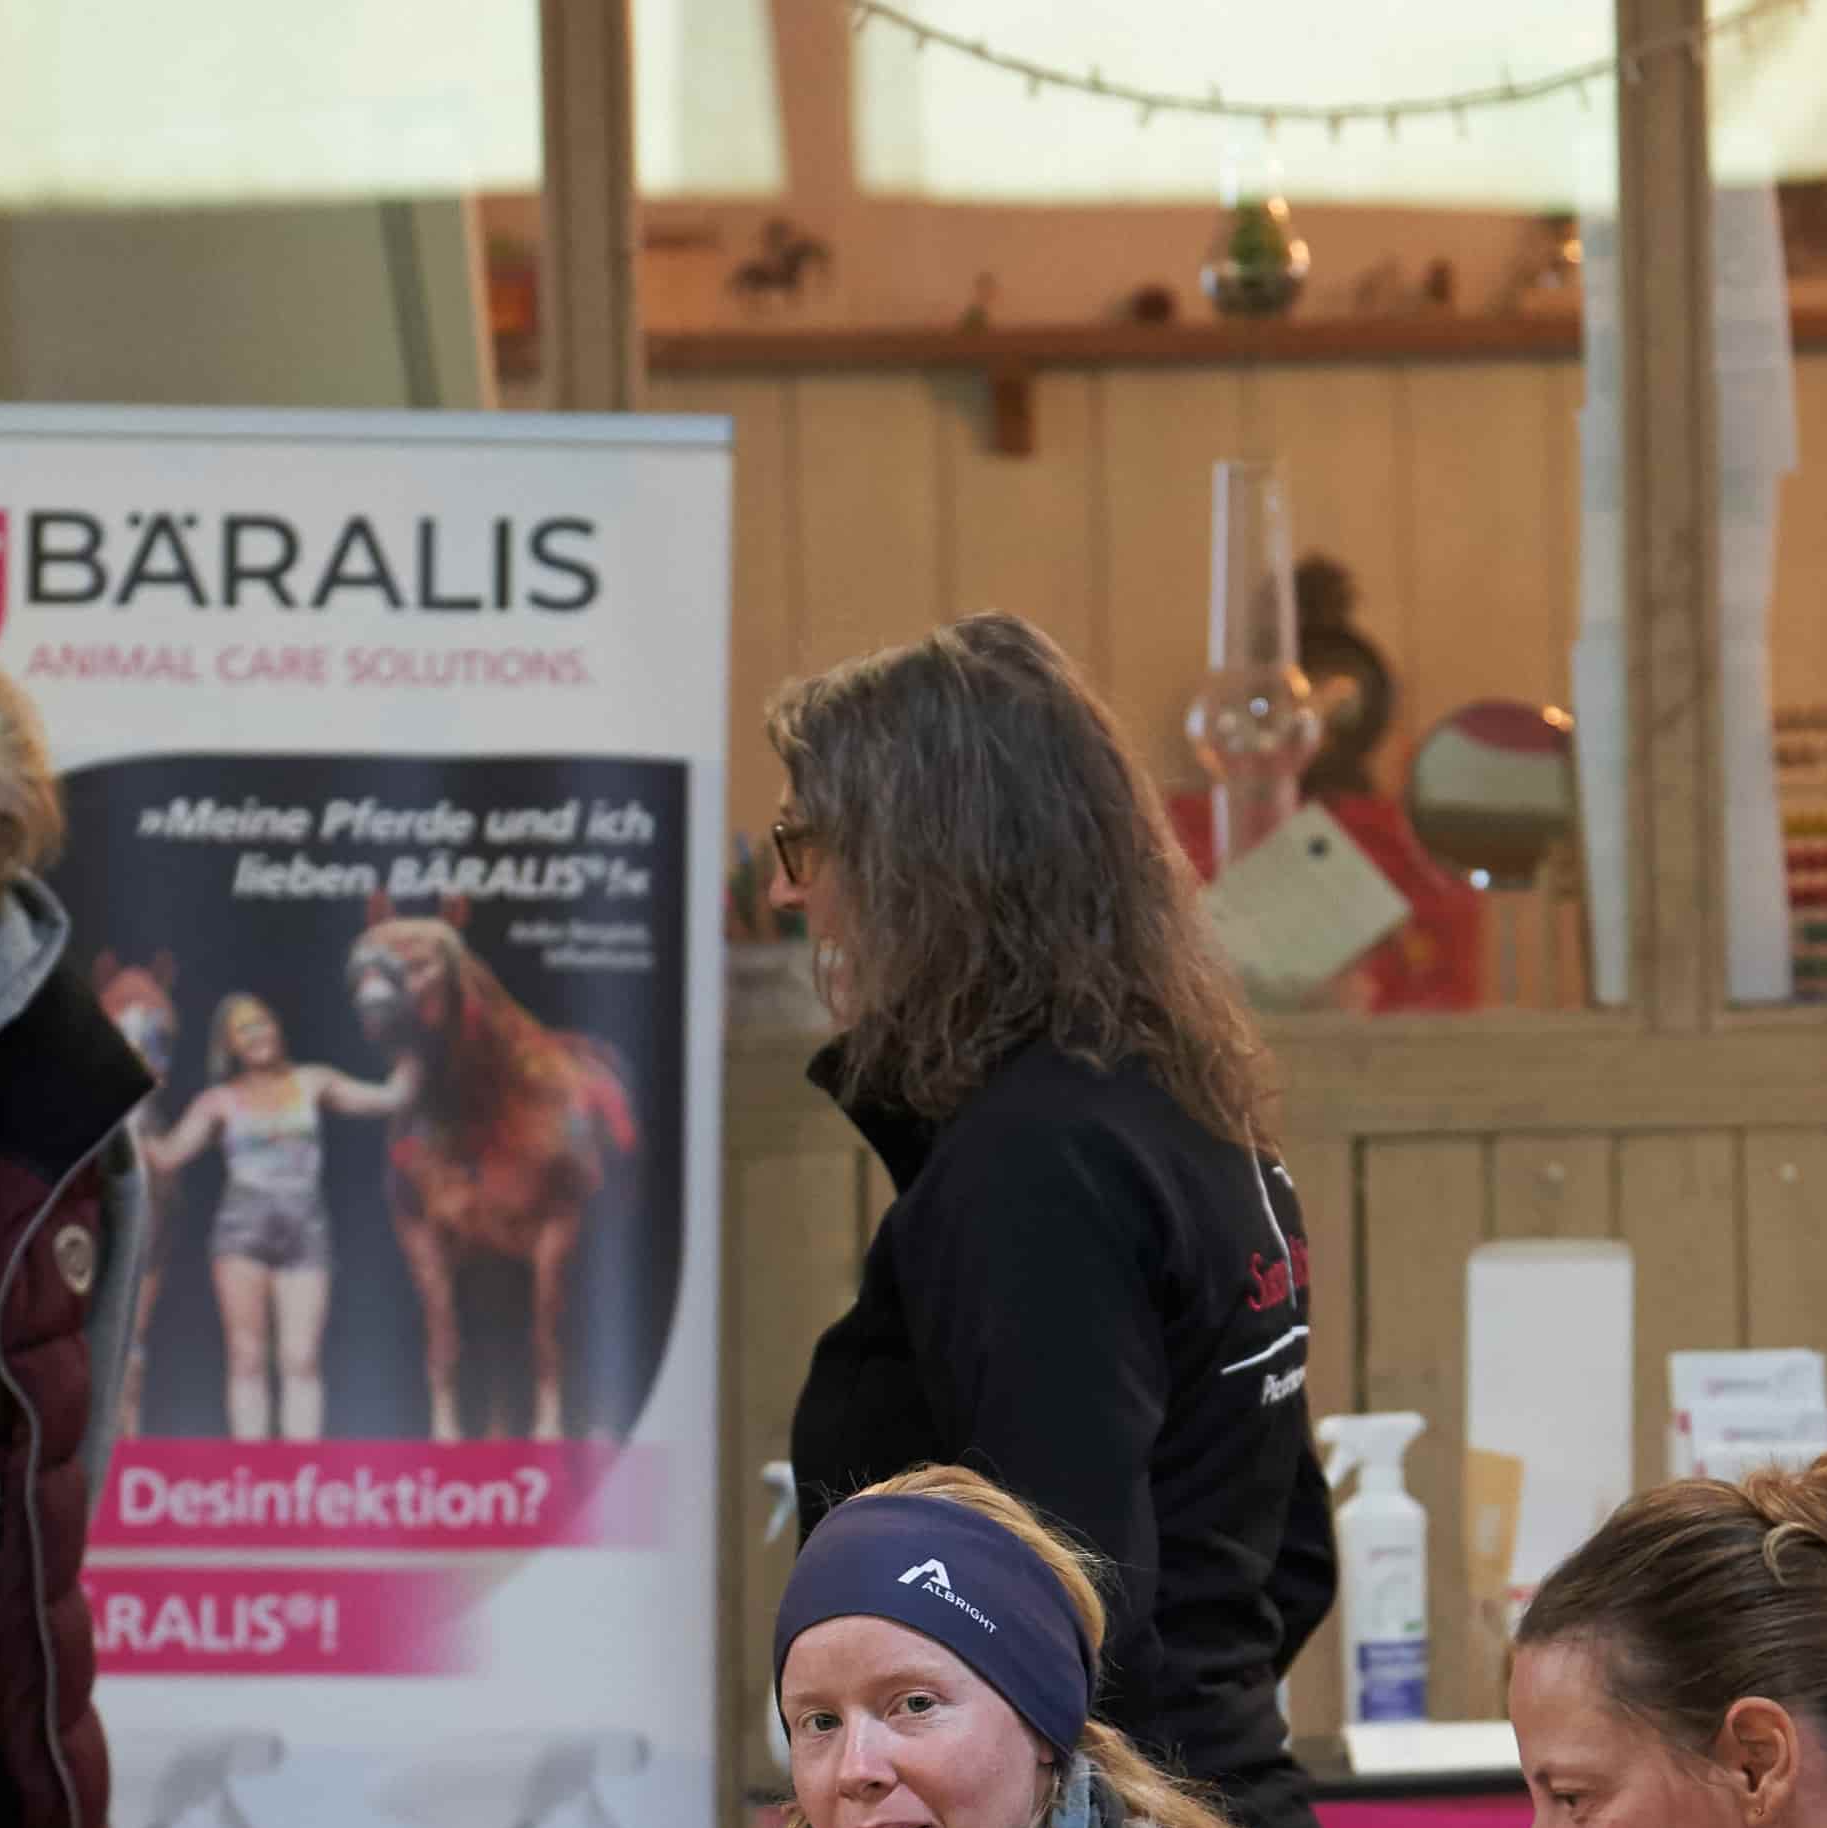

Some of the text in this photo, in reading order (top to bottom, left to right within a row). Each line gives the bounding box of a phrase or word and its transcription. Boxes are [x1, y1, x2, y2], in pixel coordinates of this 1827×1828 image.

[25, 511, 601, 613] BÄRALIS
[27, 644, 199, 683] ANIMAL
[216, 645, 328, 685] CARE
[320, 800, 475, 845] Pferde
[486, 803, 579, 844] und
[584, 803, 654, 844] ich
[232, 854, 377, 898] lieben
[118, 1466, 551, 1527] Desinfektion?
[921, 1580, 997, 1634] ALBRIGHT
